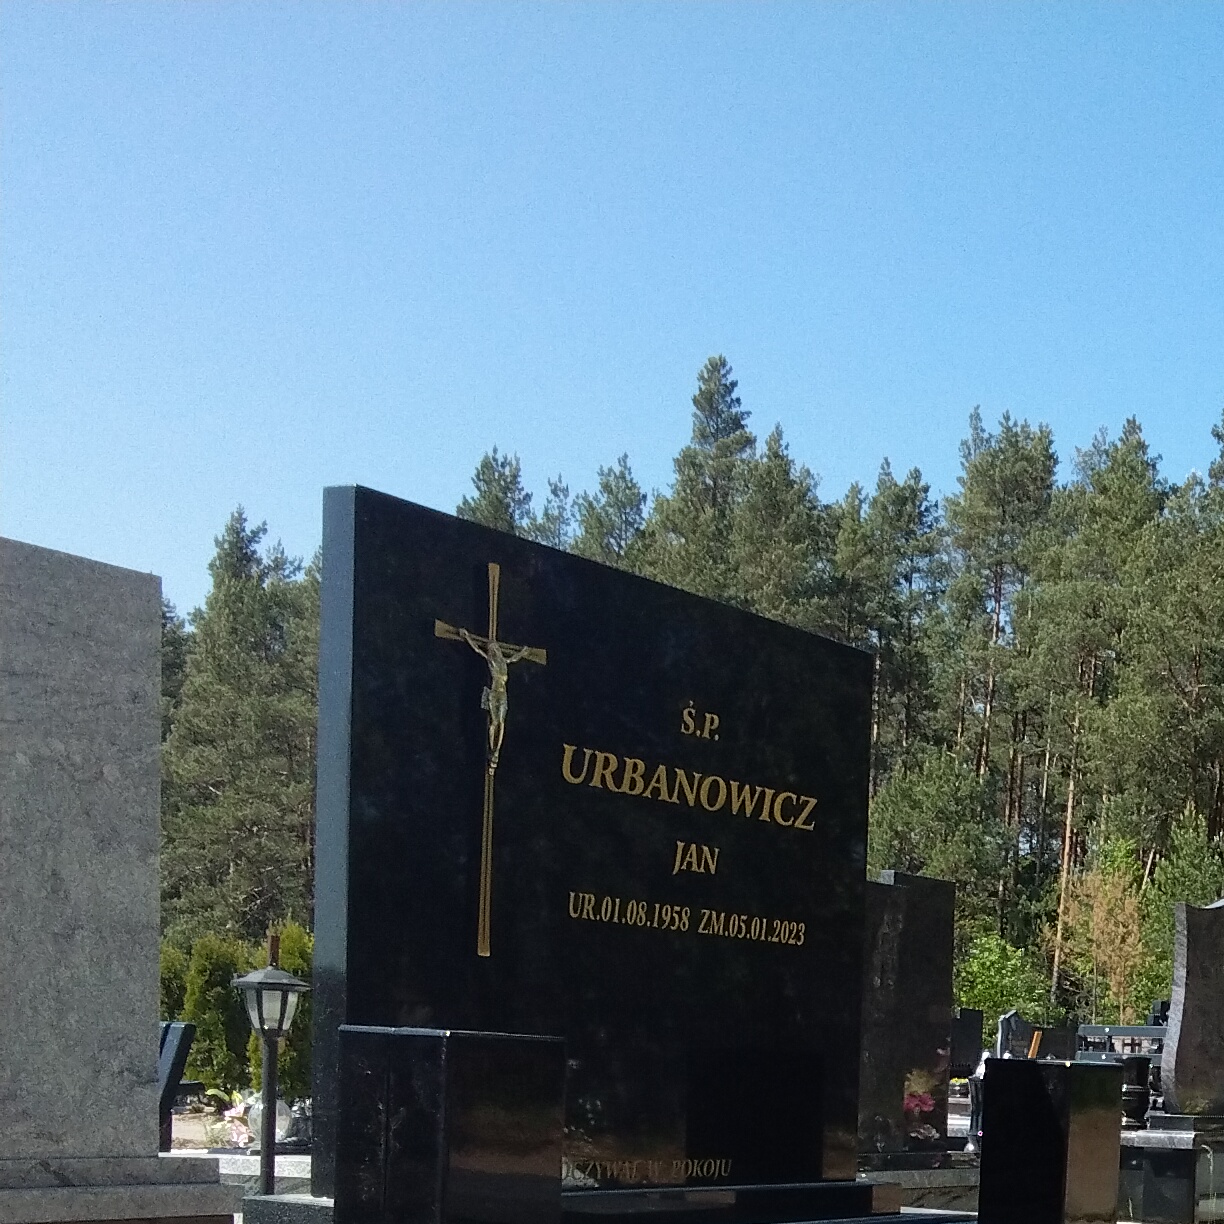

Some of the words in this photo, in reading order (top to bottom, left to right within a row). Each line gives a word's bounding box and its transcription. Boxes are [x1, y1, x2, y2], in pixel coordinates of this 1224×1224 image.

[680, 700, 720, 741] Ś.P.
[562, 743, 818, 831] URBANOWICZ
[672, 840, 720, 875] JAN
[568, 891, 691, 932] UR.01.08.1958
[697, 909, 806, 946] ZM.05.01.2023
[671, 1158, 733, 1181] POKOJU
